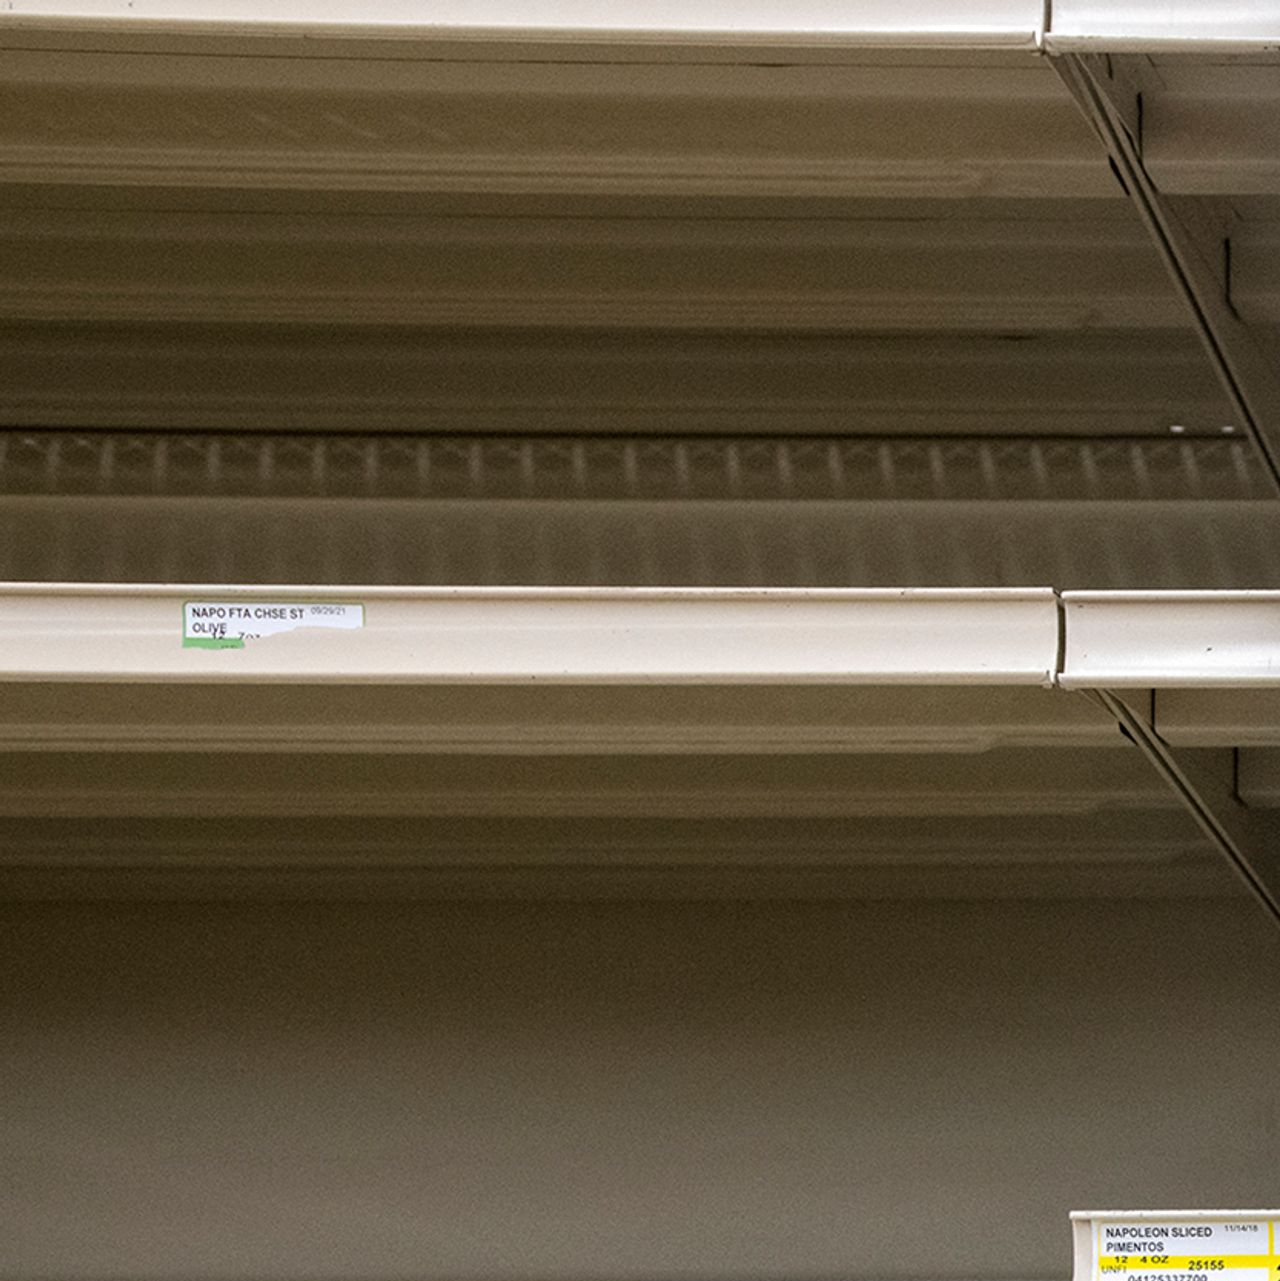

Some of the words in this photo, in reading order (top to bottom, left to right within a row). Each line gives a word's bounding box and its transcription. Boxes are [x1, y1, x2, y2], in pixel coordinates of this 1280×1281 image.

[192, 608, 226, 618] NAPO
[229, 608, 252, 618] FTA
[254, 608, 286, 619] CHSE
[290, 608, 305, 620] ST
[192, 622, 227, 634] OLIVE
[1106, 1227, 1169, 1238] NAPOLEON
[1171, 1227, 1213, 1238] SLICED
[1106, 1242, 1164, 1252] PIMENTOS
[1114, 1256, 1128, 1264] 12
[1140, 1256, 1147, 1264] 4
[1151, 1256, 1169, 1264] OZ
[1188, 1261, 1225, 1271] 25155
